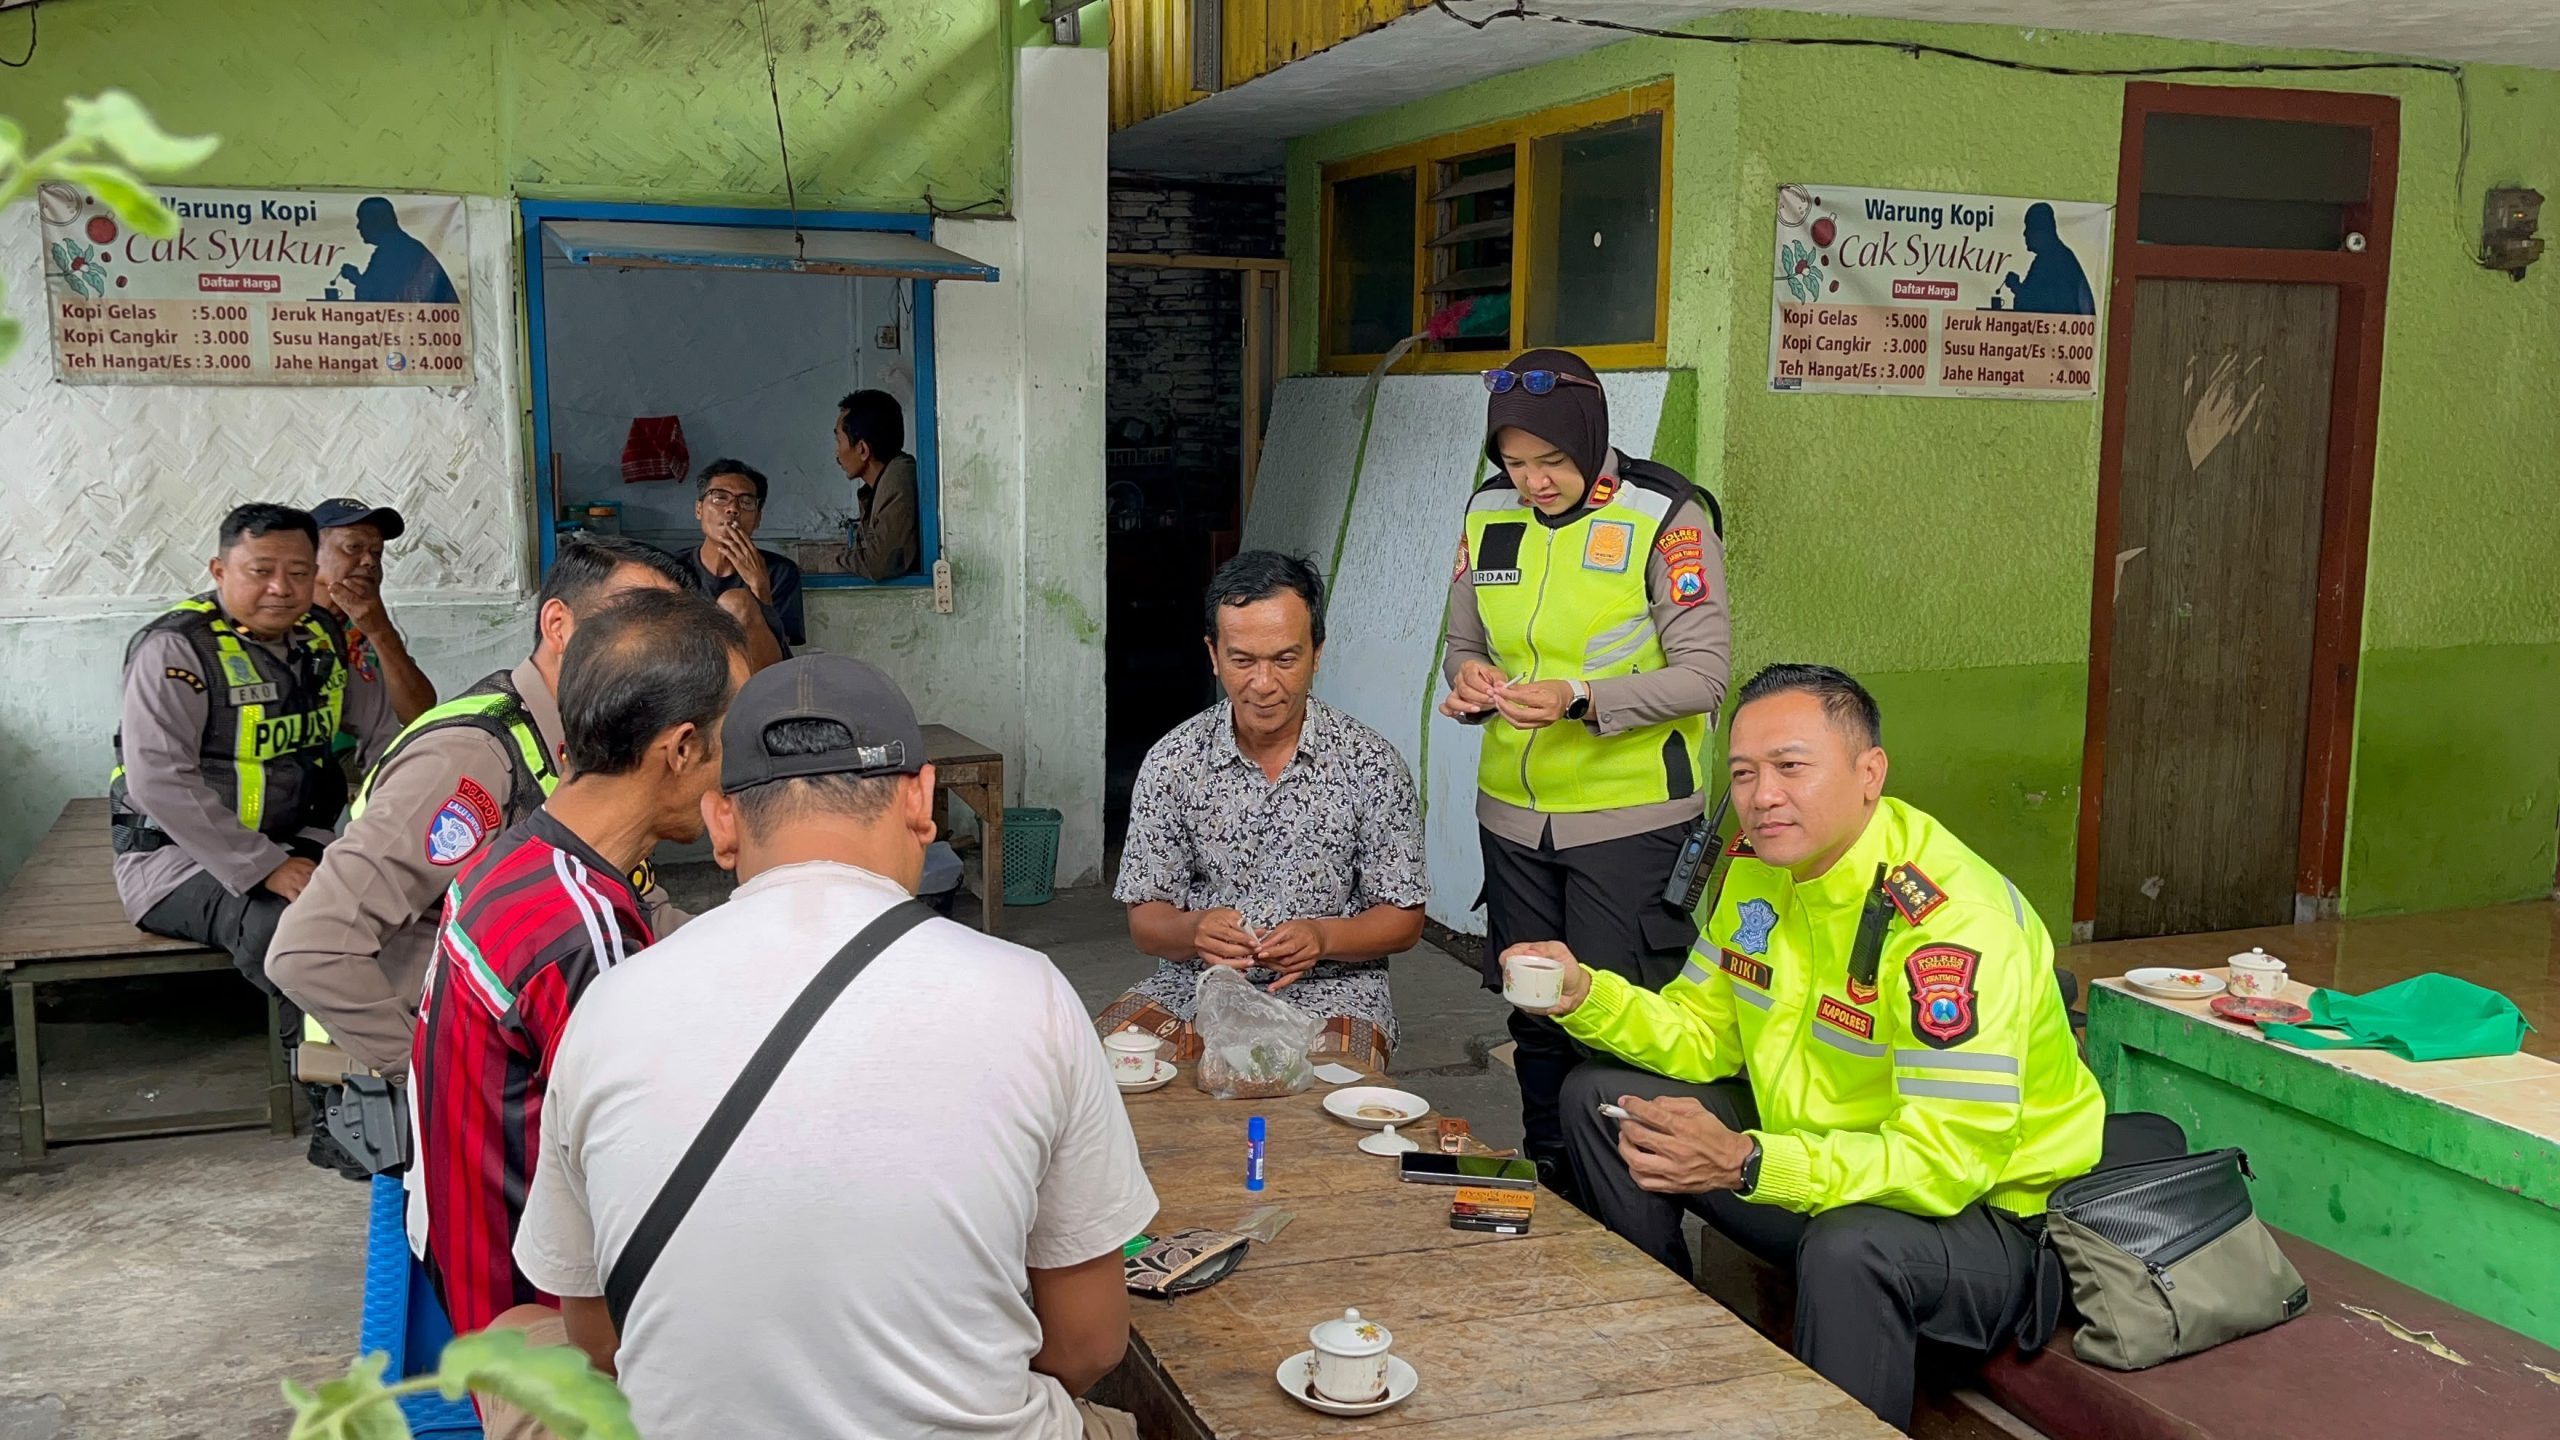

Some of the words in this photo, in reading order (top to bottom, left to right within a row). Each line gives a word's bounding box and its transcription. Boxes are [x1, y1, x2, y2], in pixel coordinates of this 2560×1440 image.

[261, 200, 317, 226] Kopi
[1865, 199, 1943, 230] Warung
[1951, 204, 1994, 232] Kopi
[126, 228, 200, 263] Cak
[208, 229, 346, 269] Syukur
[1840, 232, 1898, 268] Cak
[1904, 234, 2012, 275] Syukur
[202, 277, 240, 288] Daftar
[242, 278, 278, 290] Harga
[1894, 284, 1925, 294] Daftar
[1928, 285, 1956, 297] Harga
[62, 304, 101, 322] Kopi
[108, 304, 156, 319] Gelas
[272, 307, 316, 322] Jeruk
[322, 308, 404, 326] Hangat/Es
[1784, 309, 1813, 328] Kopi
[1818, 310, 1858, 326] Gelas
[1945, 316, 1981, 331] Jeruk
[1986, 318, 2050, 336] Hangat/Es
[64, 329, 104, 346] Kopi
[110, 329, 178, 347] Cangkir
[273, 332, 312, 346] Susu
[319, 332, 400, 349] Hangat/Es
[1782, 335, 1811, 354] Kopi
[1816, 336, 1871, 355] Cangkir
[1945, 340, 1974, 356] Susu
[1980, 342, 2045, 360] Hangat/Es
[65, 354, 96, 368] Teh
[103, 354, 191, 372] Hangat/Es
[275, 355, 312, 370] Jahe
[319, 356, 378, 372] Hangat
[1779, 360, 1803, 376] Teh
[1808, 362, 1876, 380] Hangat/Es
[1943, 365, 1972, 380] Jahe
[1978, 368, 2024, 385] Hangat
[1474, 572, 1516, 582] IRDANI
[240, 686, 270, 700] EKO
[462, 782, 497, 824] PELOPOR
[1730, 956, 1756, 982] RIKI
[1918, 955, 1964, 967] POLRES
[1822, 1003, 1866, 1032] KAPOLRES
